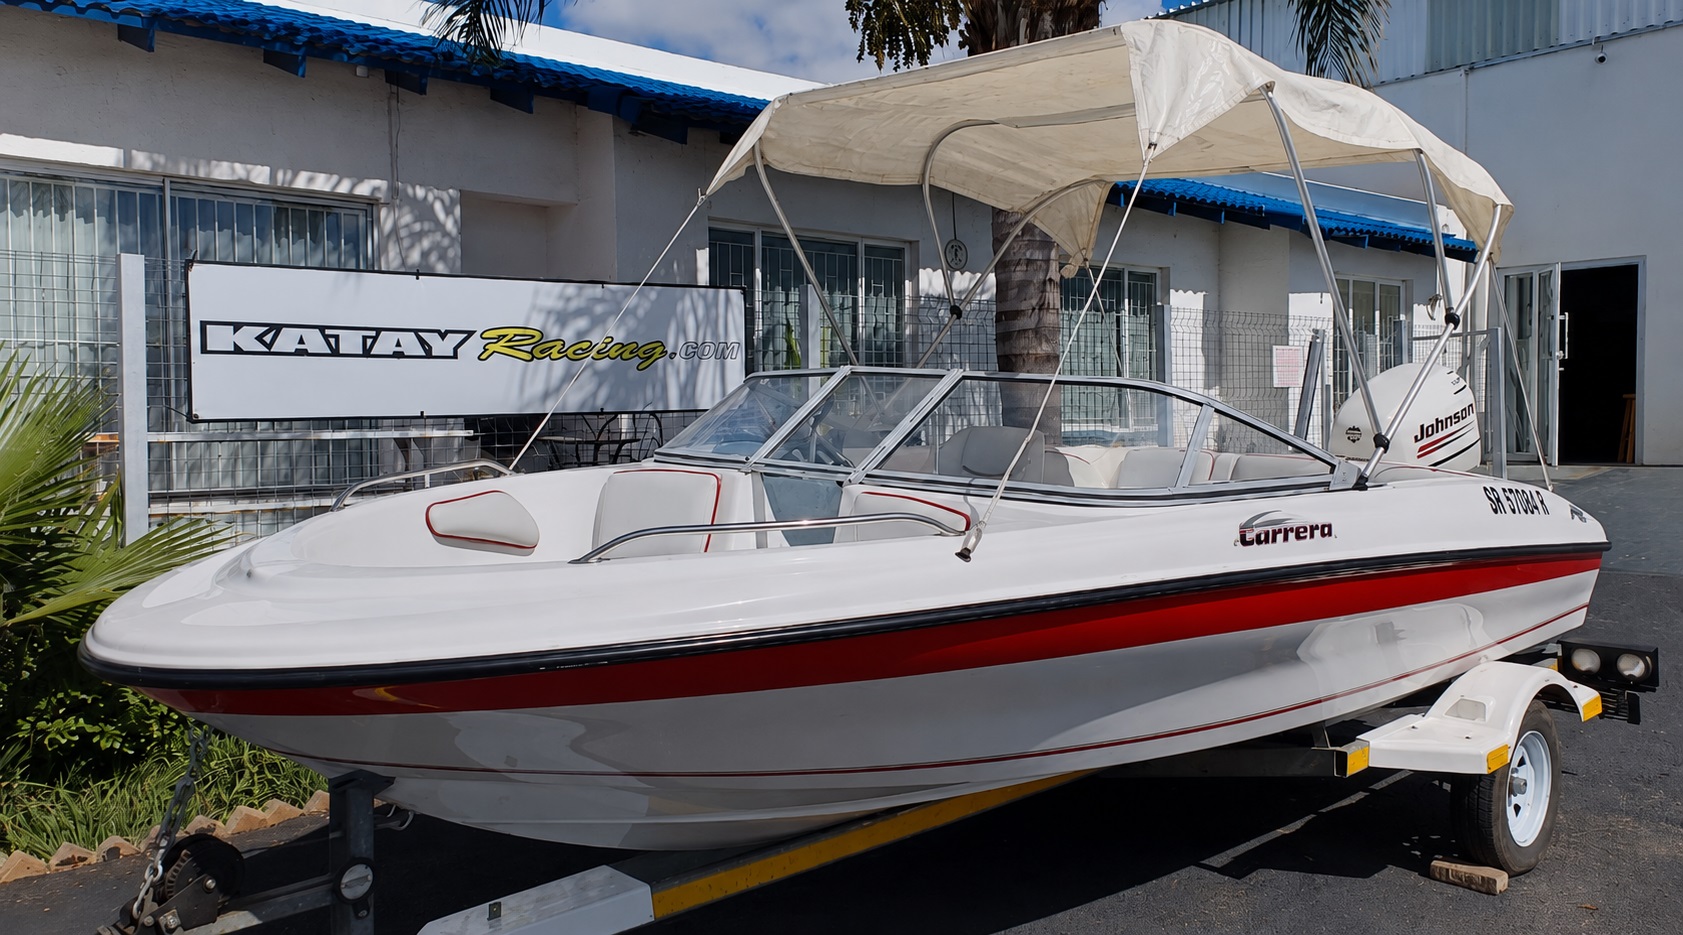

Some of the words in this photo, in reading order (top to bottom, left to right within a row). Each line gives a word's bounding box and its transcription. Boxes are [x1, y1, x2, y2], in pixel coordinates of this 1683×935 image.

[200, 320, 477, 360] KATAY
[1413, 402, 1475, 444] Johnson
[1482, 486, 1507, 515] SR
[1501, 487, 1541, 515] 57084
[1535, 490, 1550, 515] R
[1239, 522, 1333, 547] Carrera
